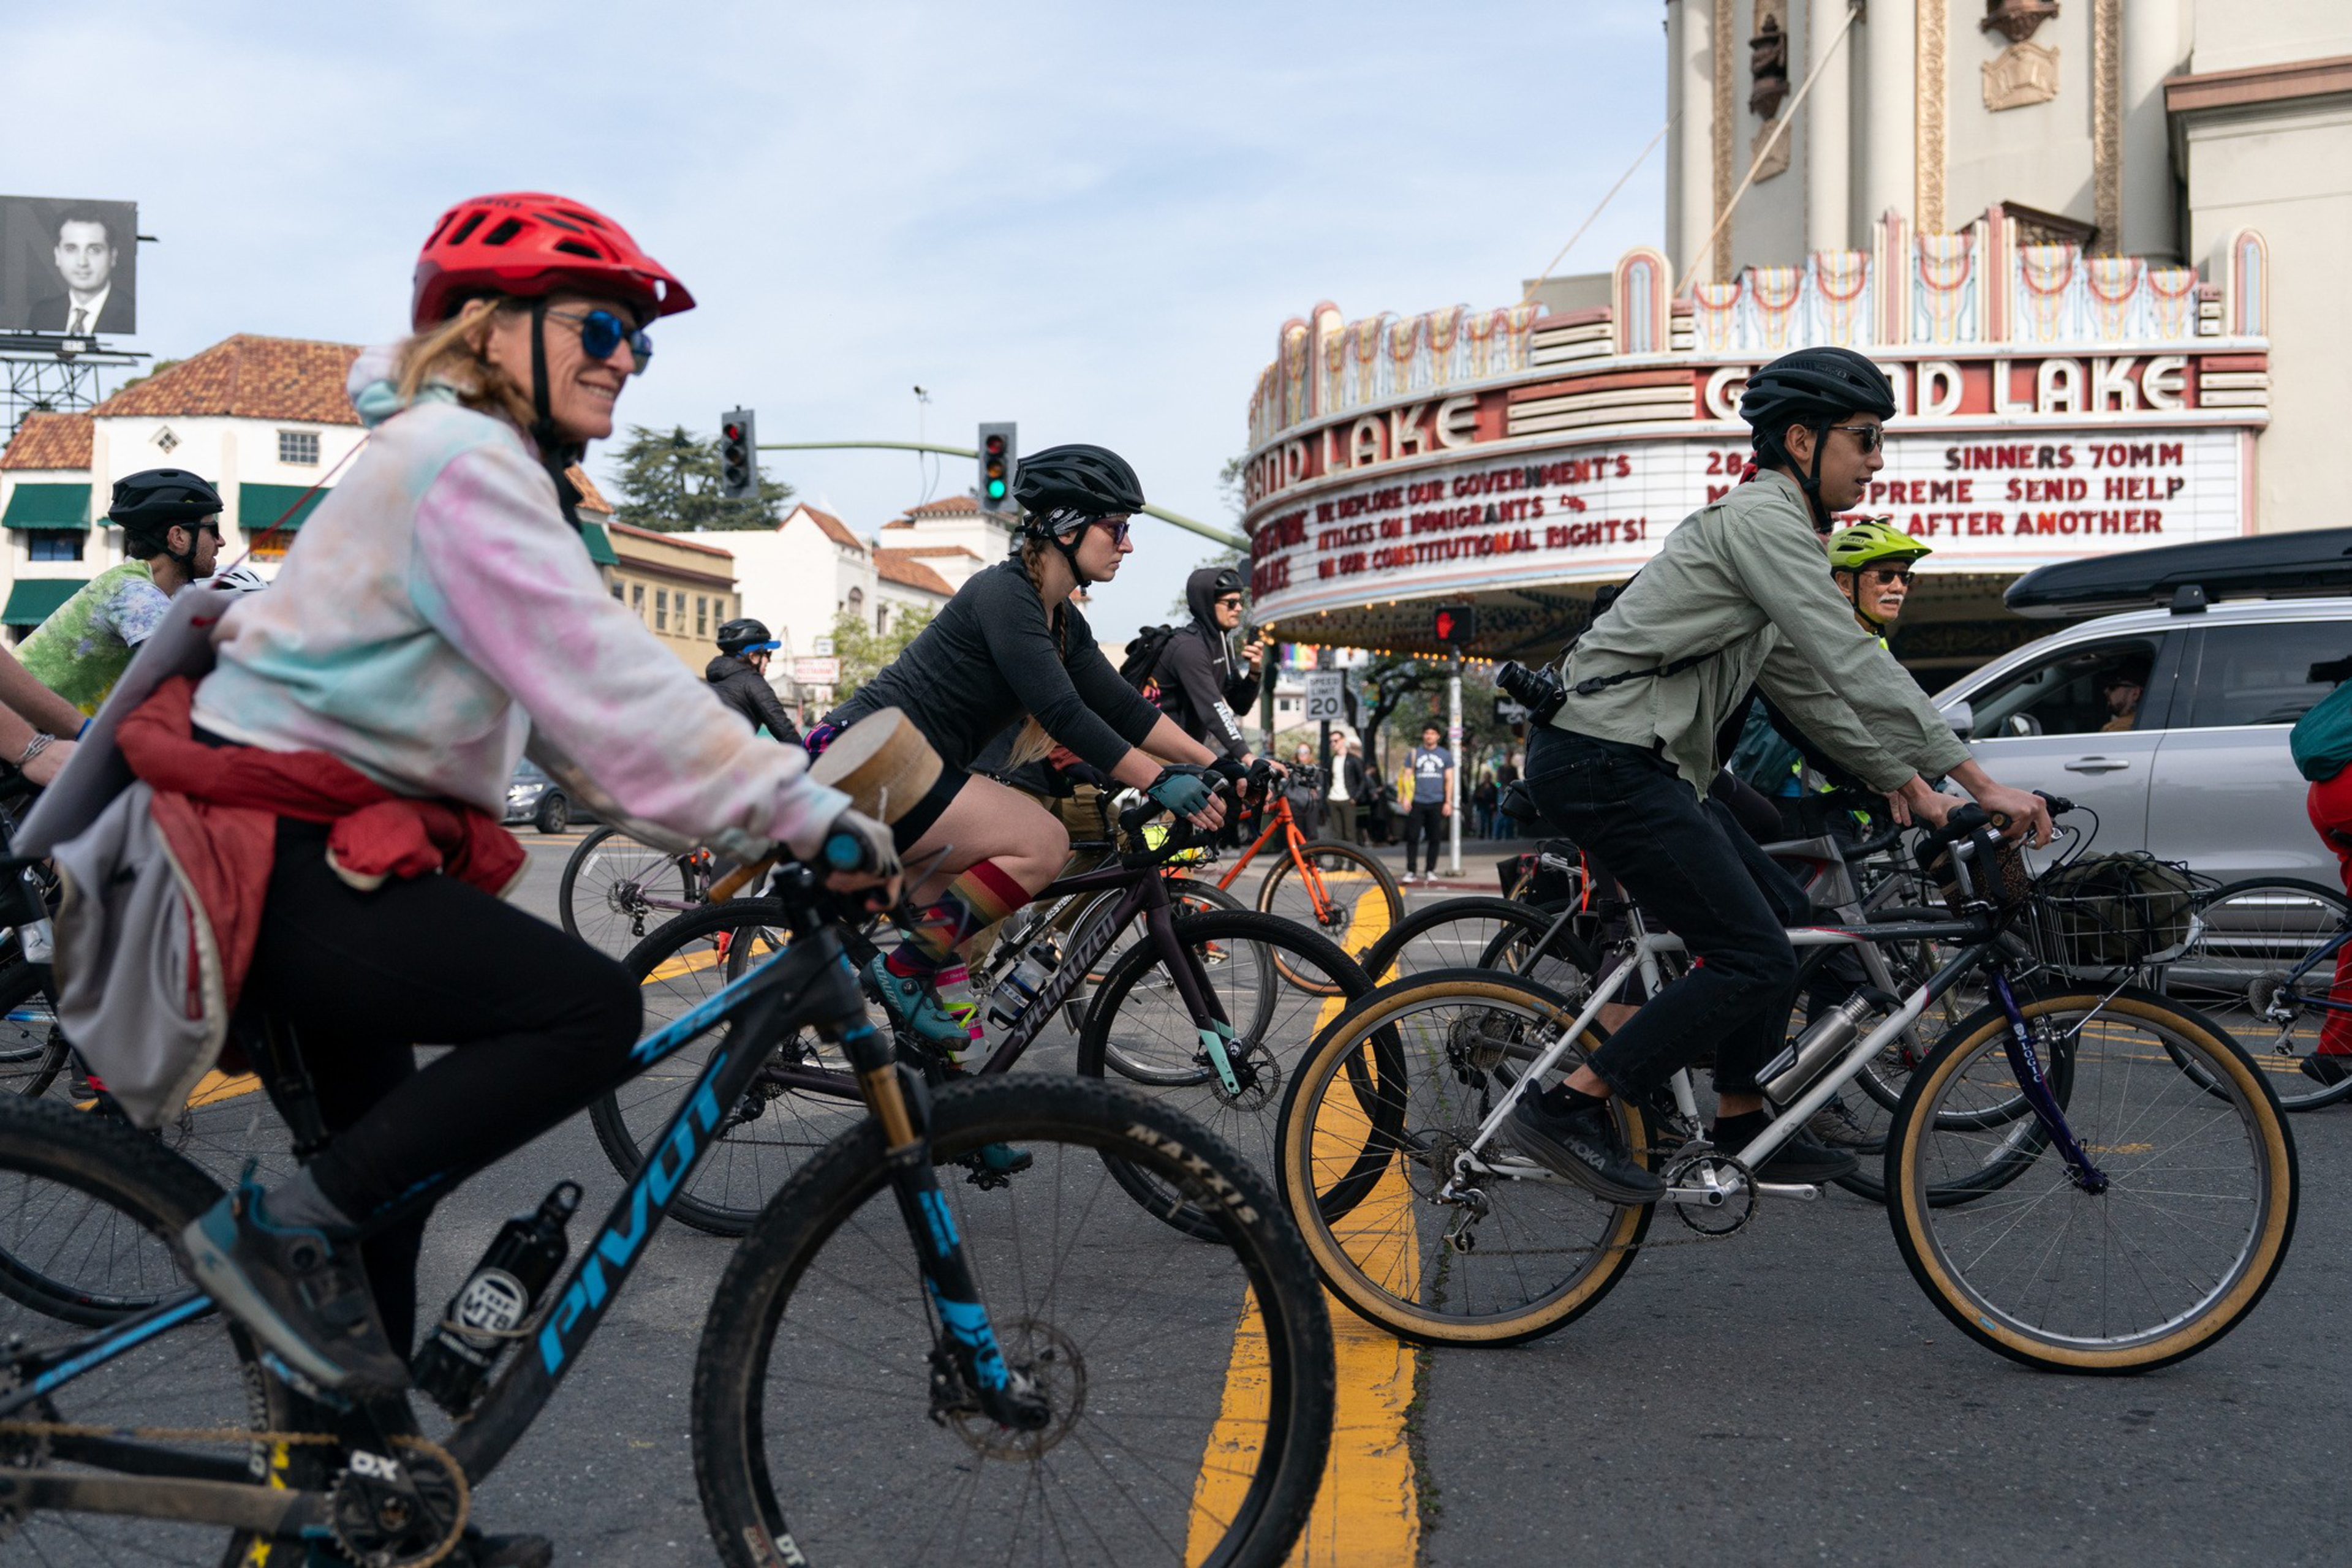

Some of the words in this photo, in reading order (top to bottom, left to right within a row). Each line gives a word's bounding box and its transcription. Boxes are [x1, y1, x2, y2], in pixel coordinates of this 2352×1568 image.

[1994, 355, 2187, 416] LAKE
[1323, 395, 1480, 477] LAKE
[1706, 451, 1742, 475] 28
[1945, 445, 2075, 470] SINNERS
[2089, 442, 2184, 469] 70MM
[1317, 500, 1334, 524] WE
[1409, 479, 1445, 505] OUR
[1453, 453, 1632, 497] GOVERNMENT'S
[2005, 477, 2088, 502] SEND
[2104, 476, 2185, 500] HELP
[1318, 521, 1375, 551] ATTACKS
[1380, 516, 1404, 540] ON
[1410, 494, 1545, 536] IMMIGRANTS
[1339, 551, 1367, 576] OUR
[1373, 528, 1538, 571] CONSTITUTIONAL
[1545, 517, 1647, 550] RIGHTS!
[1907, 511, 2005, 537] AFTER
[2014, 510, 2163, 535] ANOTHER
[1310, 697, 1339, 715] 20
[1014, 911, 1117, 1048] SPECIALIZED
[2021, 1042, 2042, 1083] LOGIC
[1126, 1123, 1260, 1224] MAXXIS
[1563, 1136, 1606, 1171] HOKA
[539, 1052, 728, 1376] PIVOT
